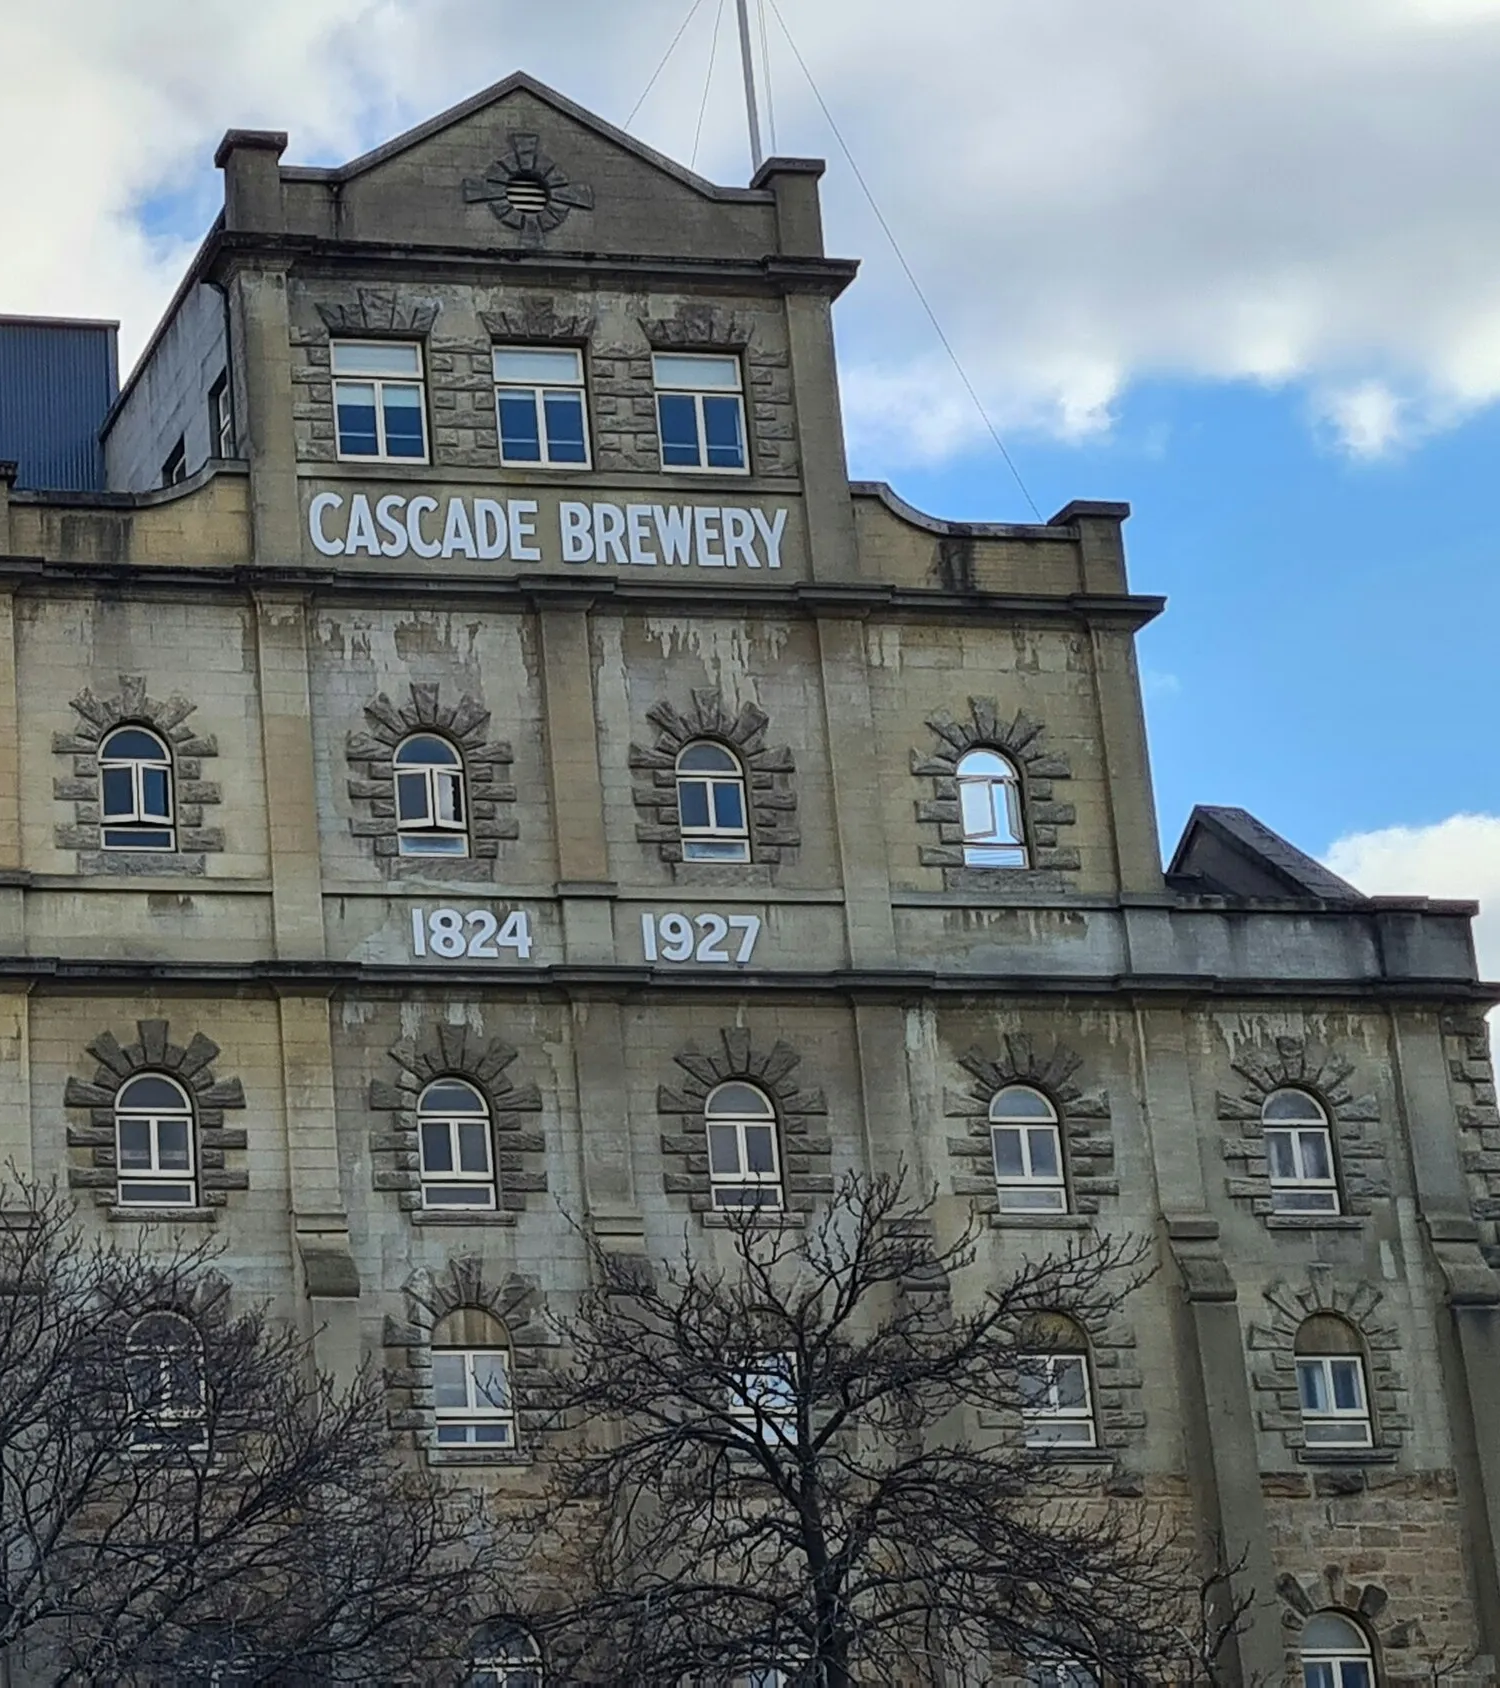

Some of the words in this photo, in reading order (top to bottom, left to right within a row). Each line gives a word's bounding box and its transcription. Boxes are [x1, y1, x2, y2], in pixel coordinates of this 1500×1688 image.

[308, 492, 541, 561] CASCADE
[559, 501, 788, 568] BREWERY
[411, 908, 532, 958] 1824
[641, 913, 761, 962] 1927
